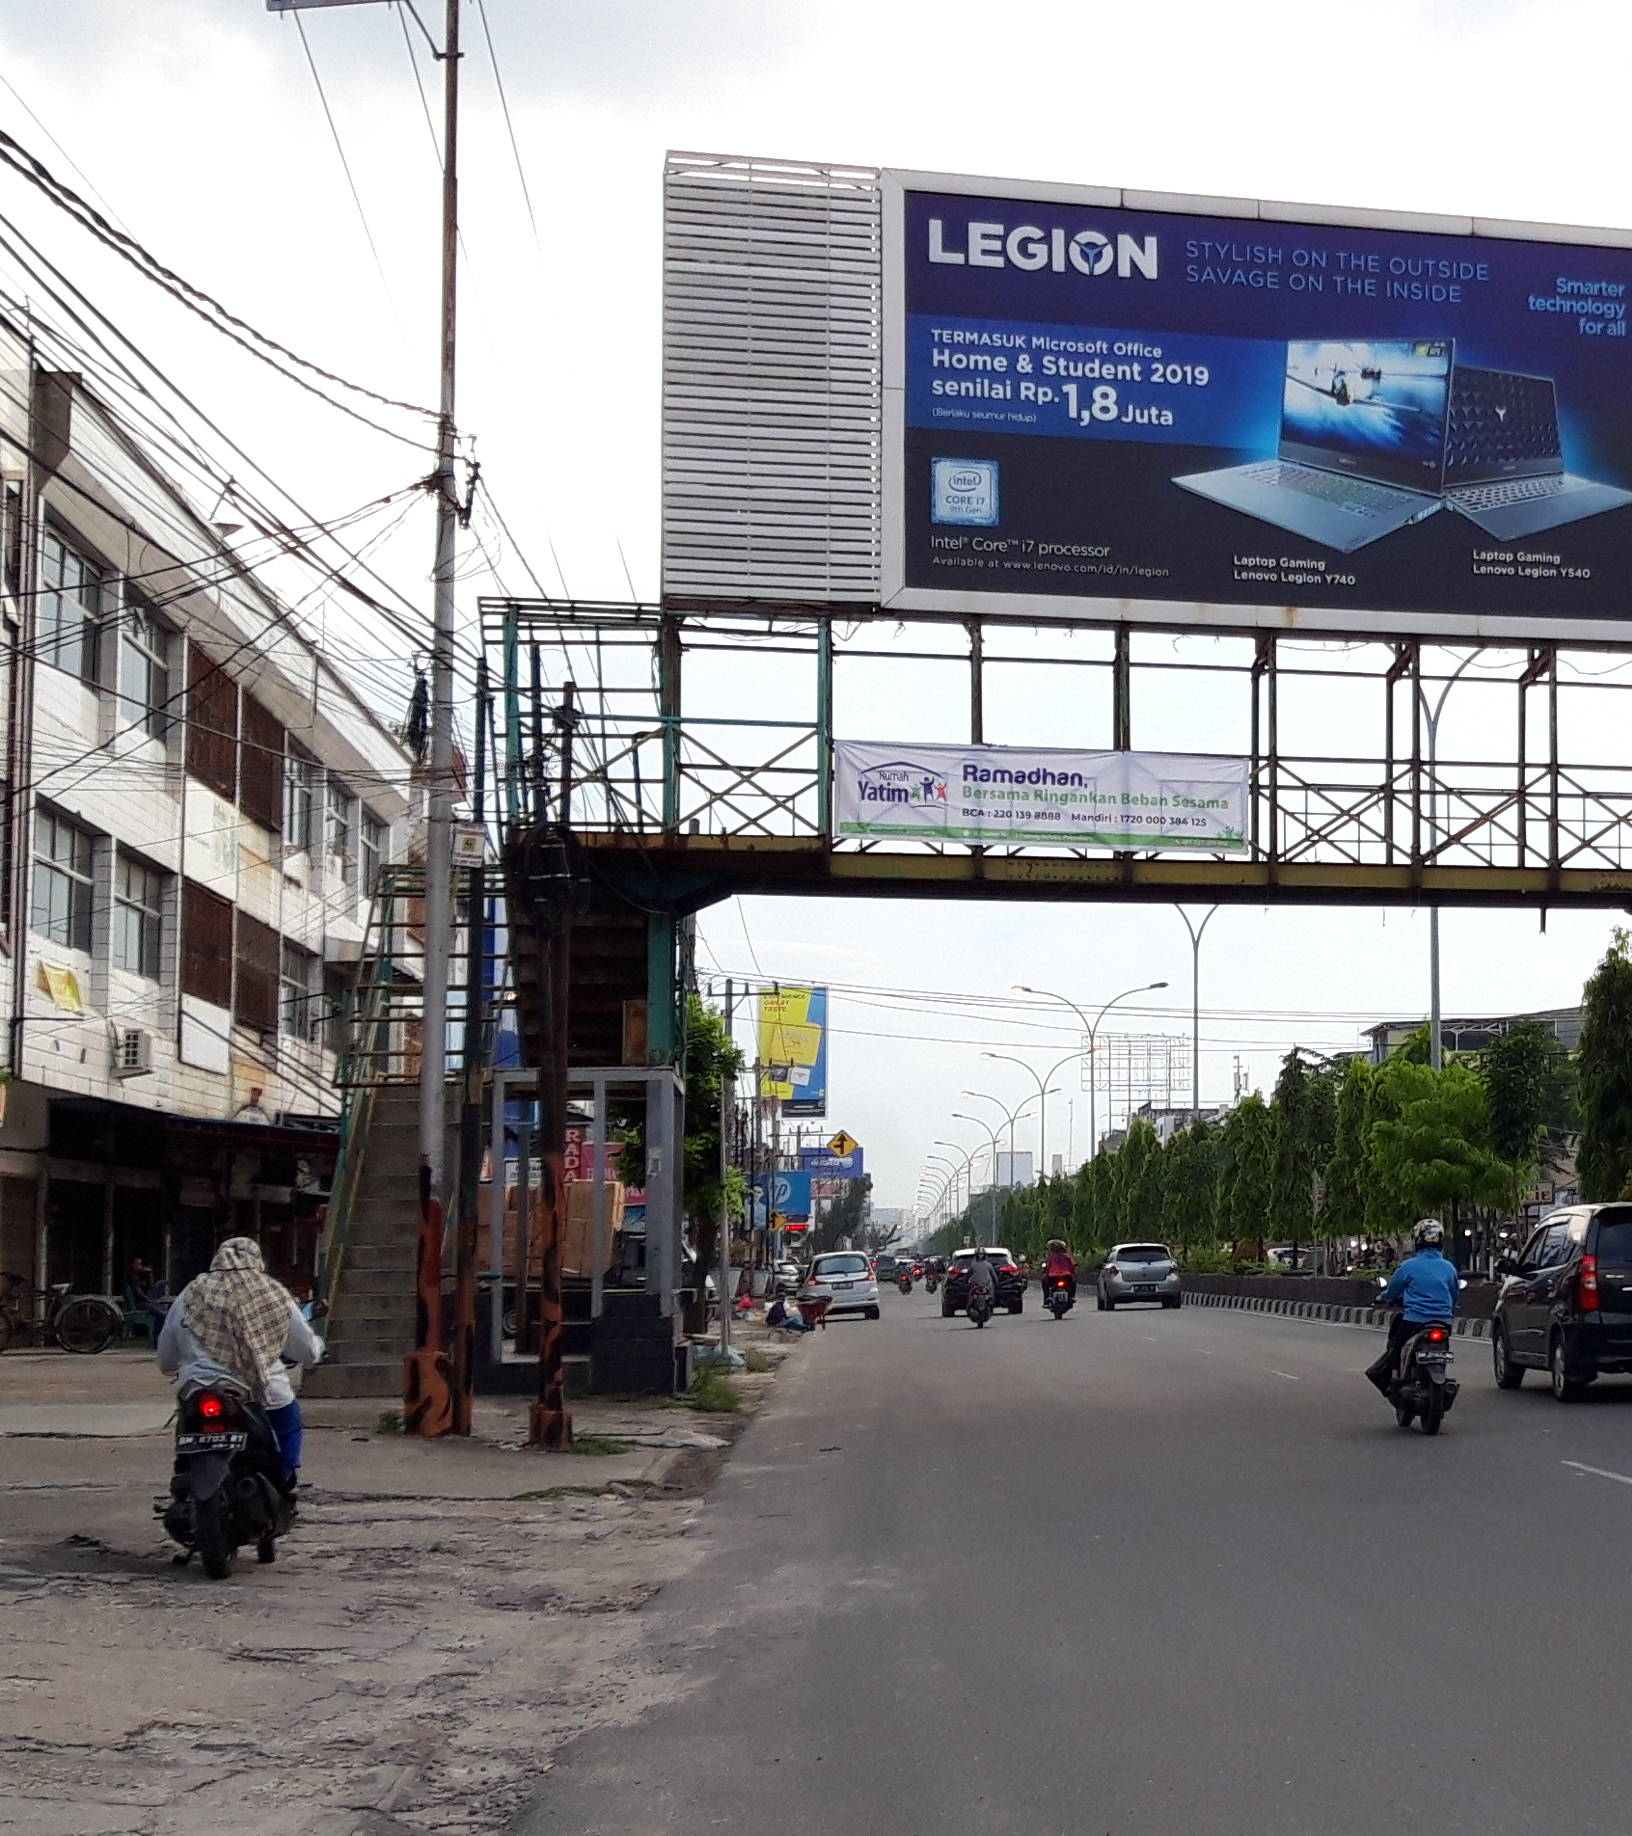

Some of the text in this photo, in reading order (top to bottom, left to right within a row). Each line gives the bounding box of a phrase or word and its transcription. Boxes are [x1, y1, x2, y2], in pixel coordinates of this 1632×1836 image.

[928, 218, 1158, 280] LEGION
[1186, 240, 1489, 281] STYLISH ON THE OUTSIDE
[1186, 265, 1463, 302] SAVAGE ON THE INSIDE
[1556, 277, 1625, 298] Smarter
[1528, 295, 1626, 319] technology
[1579, 317, 1626, 337] for all
[931, 328, 1162, 359] TERMASUK Microsoft Office
[932, 348, 1210, 387] Home & Student 2019
[931, 378, 1174, 427] senilai Rp. 1,8 Juta
[952, 474, 978, 487] intel
[945, 495, 974, 505] CORE
[1021, 540, 1035, 554] i7
[1038, 542, 1111, 558] processor
[1472, 549, 1561, 566] Laptop Gaming
[932, 556, 984, 568] Available
[987, 559, 1000, 568] at
[1234, 555, 1326, 572] Laptop Gaming
[1472, 564, 1591, 579] Lenovo Legion Y540
[1234, 569, 1356, 586] Lenovo Legion Y740
[878, 769, 910, 782] Rumah
[962, 763, 1088, 789] Ramadhan,
[857, 780, 909, 803] Yatim
[962, 785, 1229, 810] Bersama Ringankan Beban Sesama
[961, 808, 985, 818] BCA
[993, 809, 1012, 819] 220
[1071, 813, 1113, 823] Mandiri
[1120, 815, 1143, 824] 1720
[1146, 816, 1166, 825] 000
[1191, 817, 1208, 827] 125
